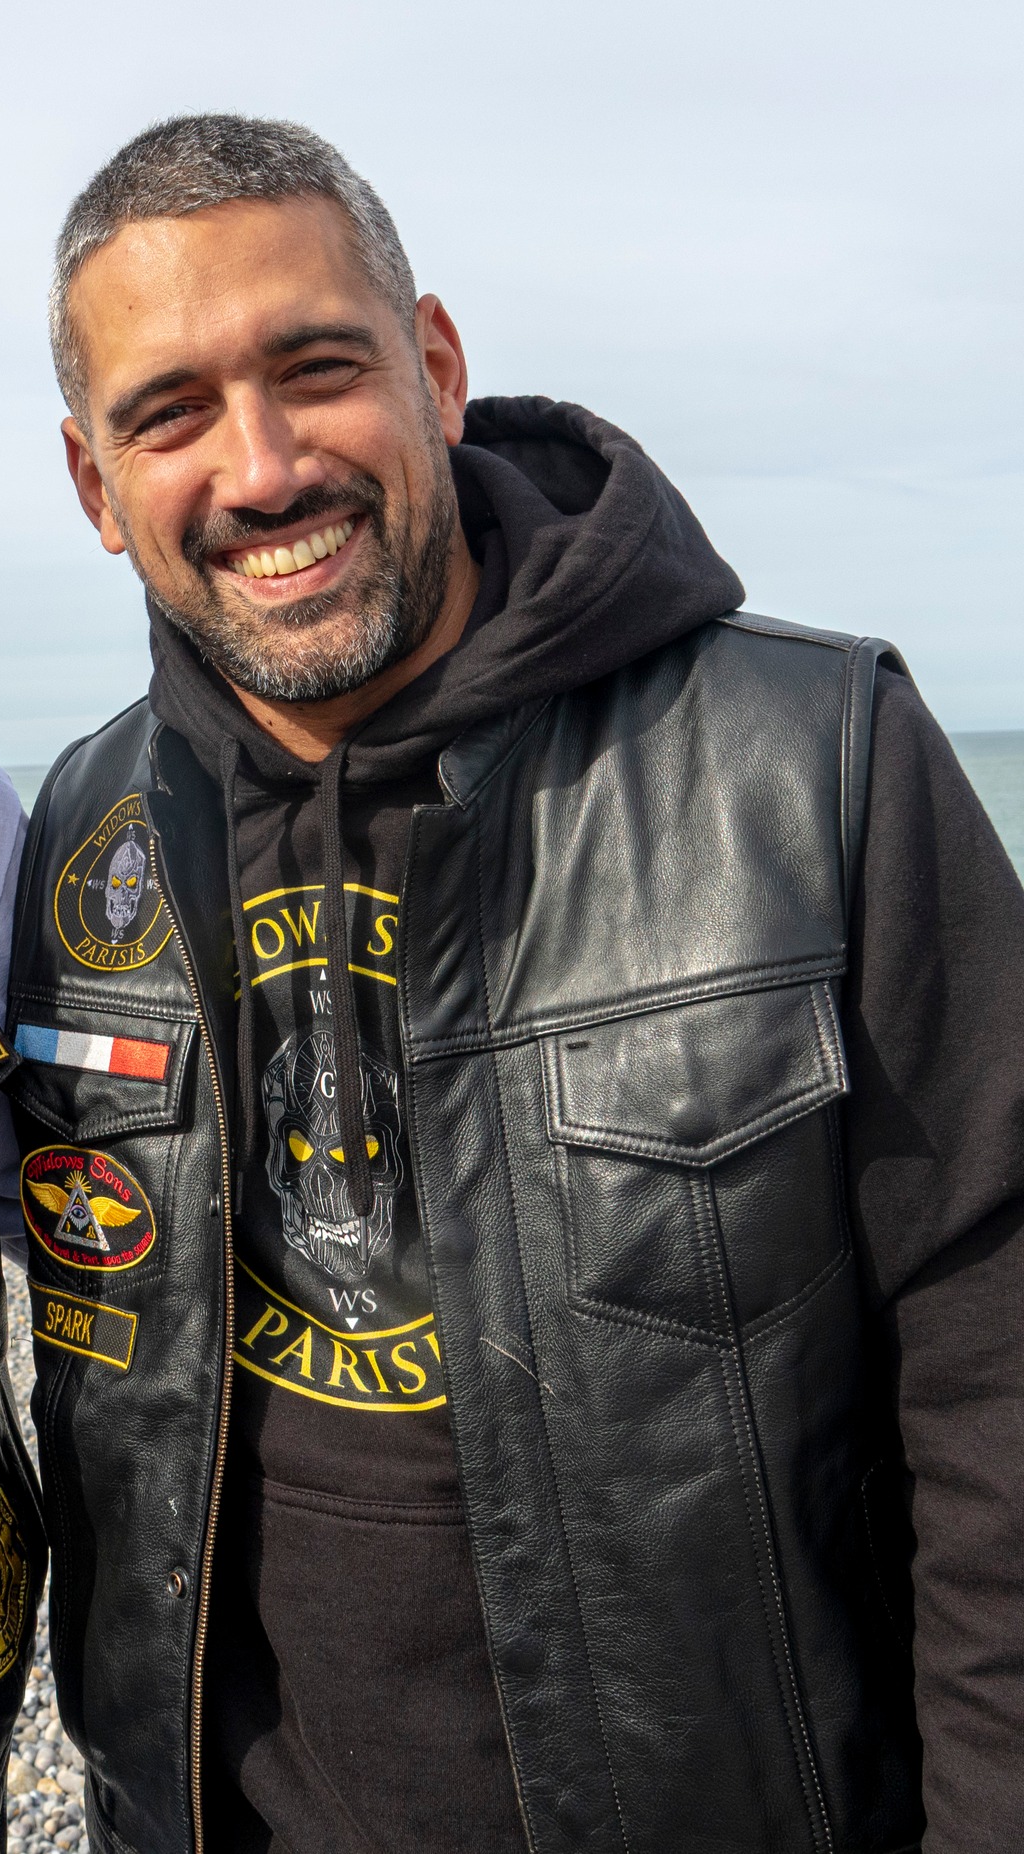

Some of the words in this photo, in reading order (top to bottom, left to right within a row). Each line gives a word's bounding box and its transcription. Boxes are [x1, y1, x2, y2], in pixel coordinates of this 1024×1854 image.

[94, 801, 142, 848] WIDOWS
[92, 879, 105, 889] WS
[110, 927, 125, 939] WS
[75, 936, 146, 966] PARISIS
[27, 1152, 85, 1180] Widows
[89, 1156, 132, 1203] Sons
[328, 1288, 378, 1314] WS
[45, 1301, 95, 1345] SPARK
